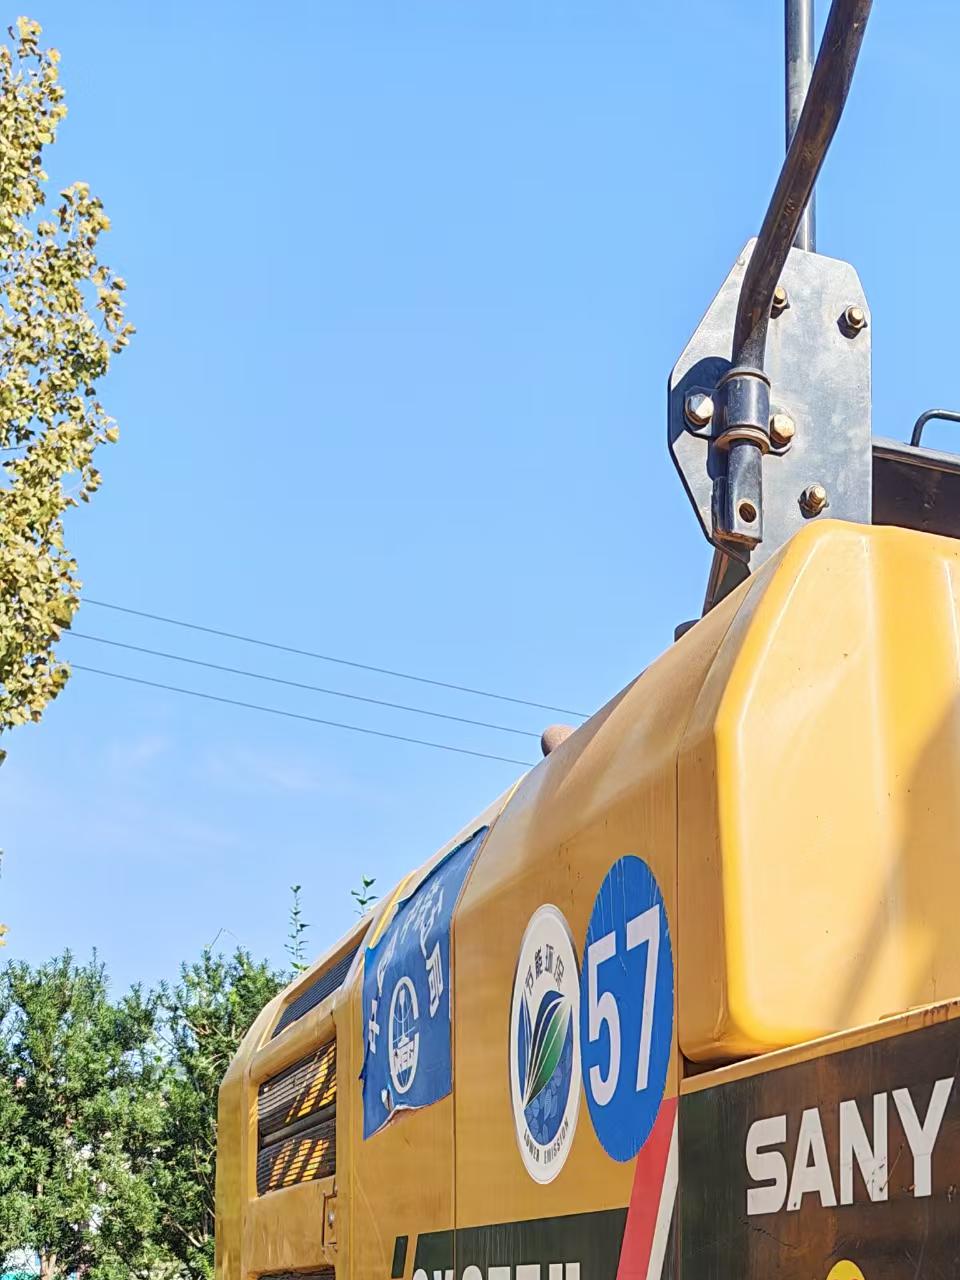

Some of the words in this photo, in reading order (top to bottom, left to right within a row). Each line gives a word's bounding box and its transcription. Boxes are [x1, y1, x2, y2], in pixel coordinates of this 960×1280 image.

[525, 944, 564, 996] 节能环保
[587, 904, 660, 1106] 57
[523, 1128, 539, 1163] LOWER
[544, 1117, 569, 1164] EMISSION
[745, 1077, 955, 1216] SANY
